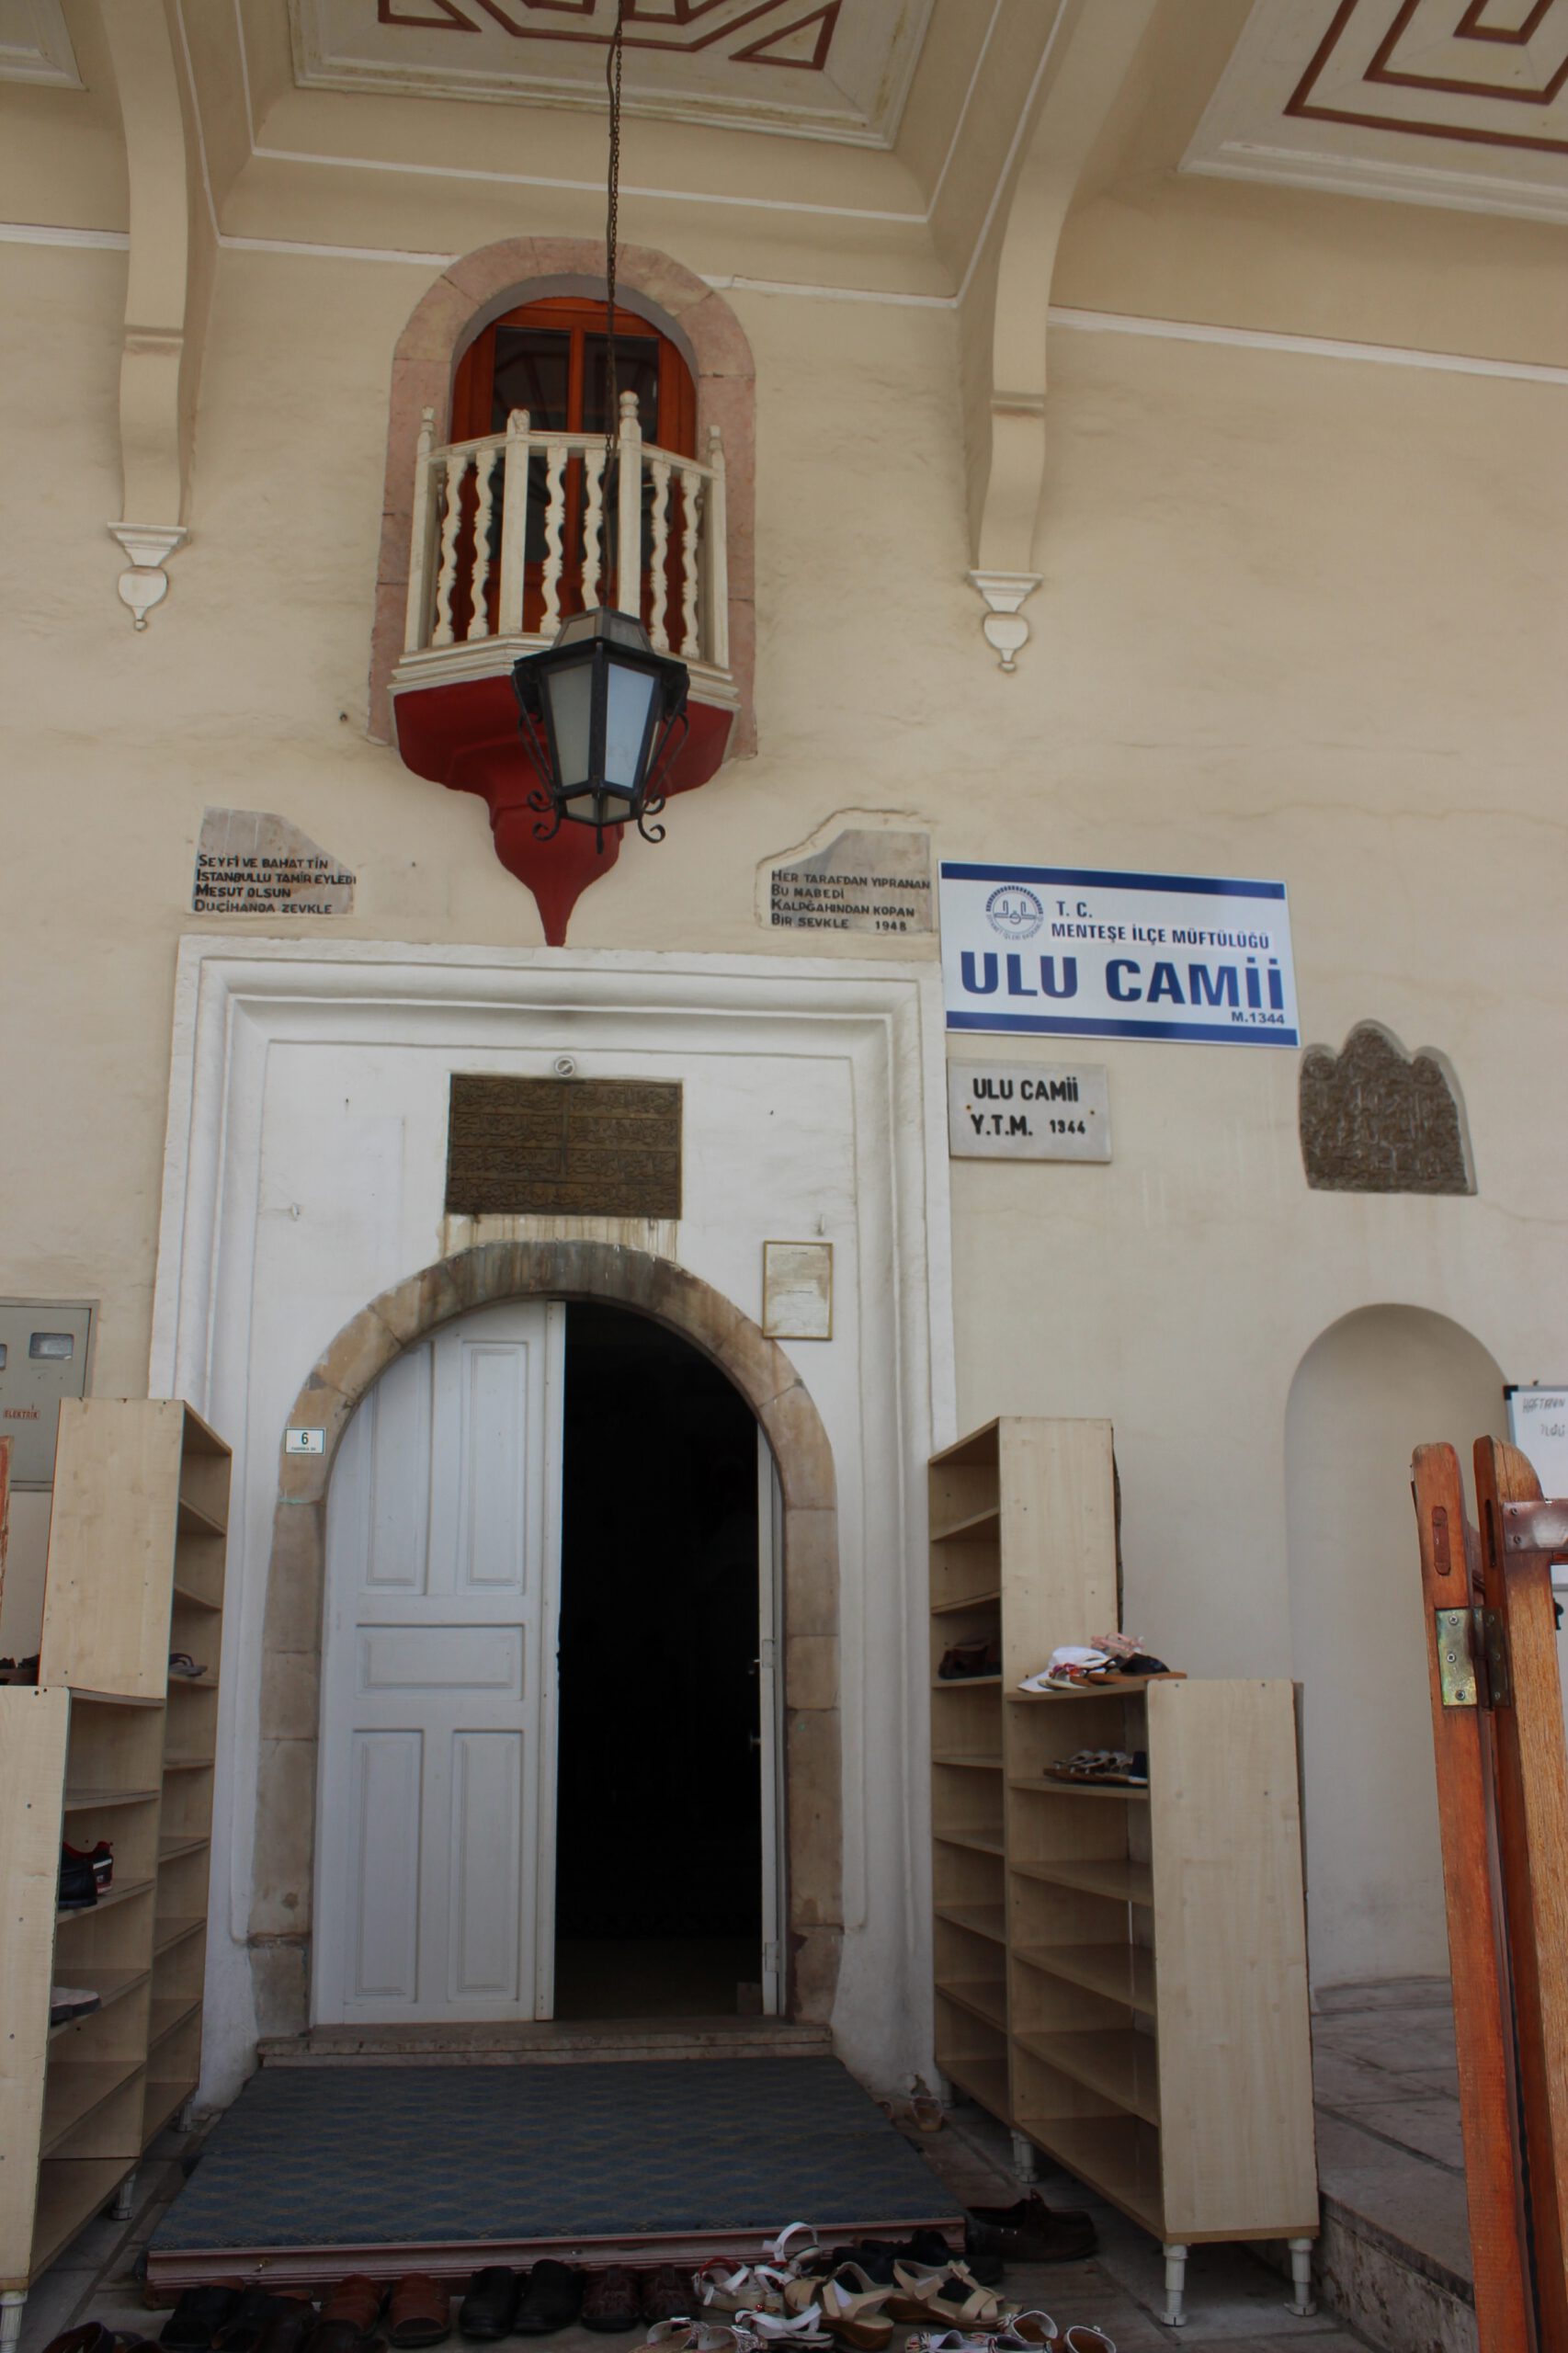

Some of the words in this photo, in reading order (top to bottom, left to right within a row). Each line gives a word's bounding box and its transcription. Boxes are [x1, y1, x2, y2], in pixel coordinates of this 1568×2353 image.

[243, 858, 258, 869] VE
[771, 870, 799, 882] HER
[803, 873, 868, 887] TARAFDAN
[871, 877, 930, 890] YIPRANAN
[196, 884, 244, 897] MESUT
[247, 887, 291, 899] OLSUN
[771, 884, 789, 897] BU
[281, 904, 332, 915] ZEVKLE
[873, 905, 915, 917] KOPAN
[875, 921, 907, 932] 1948
[1051, 923, 1127, 944] MENTEŞE
[1132, 924, 1166, 946] İLÇE
[1172, 927, 1270, 950] MÜFTÜLÜĞÜ
[960, 951, 1078, 998] ULU
[1106, 957, 1284, 1010] CAMİİ
[1231, 1011, 1285, 1025] M.1344
[971, 1078, 1012, 1100] ULU
[1020, 1077, 1079, 1102] CAMİİ
[971, 1115, 1033, 1136] Y.T.M.
[1050, 1120, 1085, 1134] 1344
[301, 1432, 309, 1445] 6
